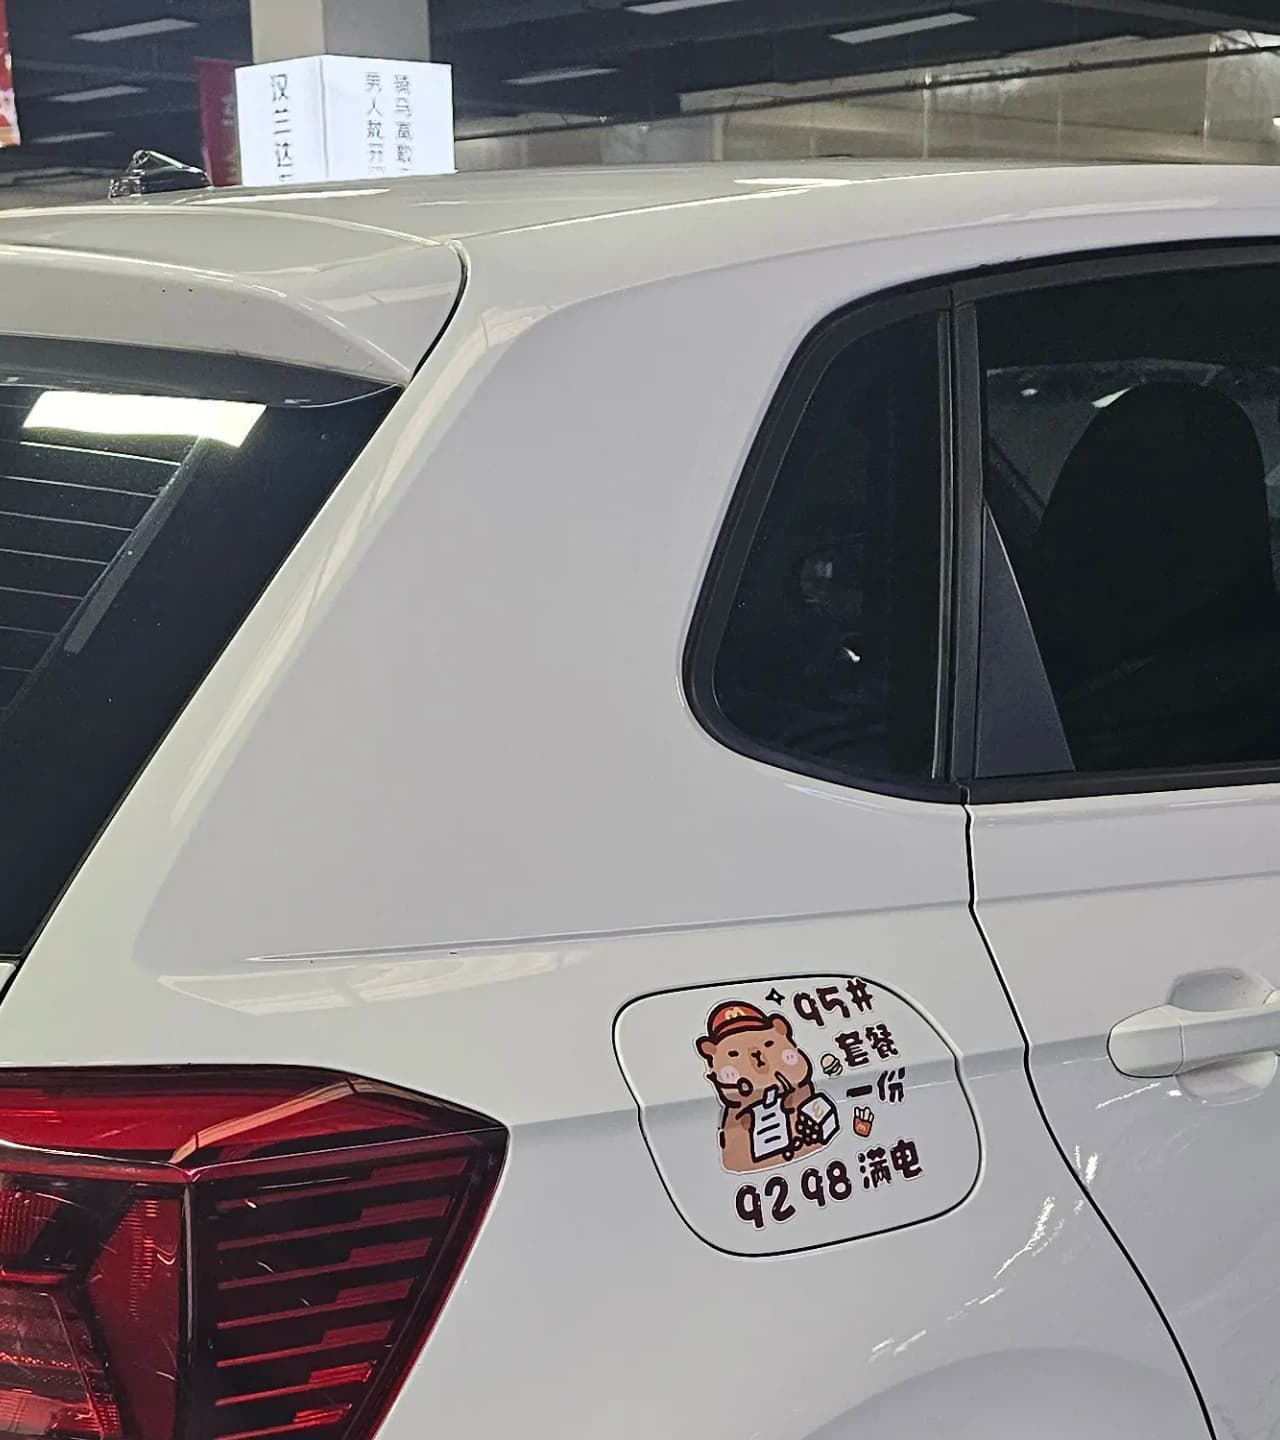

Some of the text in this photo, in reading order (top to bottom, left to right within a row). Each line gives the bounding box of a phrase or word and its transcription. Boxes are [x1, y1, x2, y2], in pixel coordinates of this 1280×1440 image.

[793, 978, 873, 1027] 95#
[835, 1024, 899, 1067] 套餐
[846, 1067, 906, 1103] 一份
[735, 1139, 922, 1228] 92 98 满电
